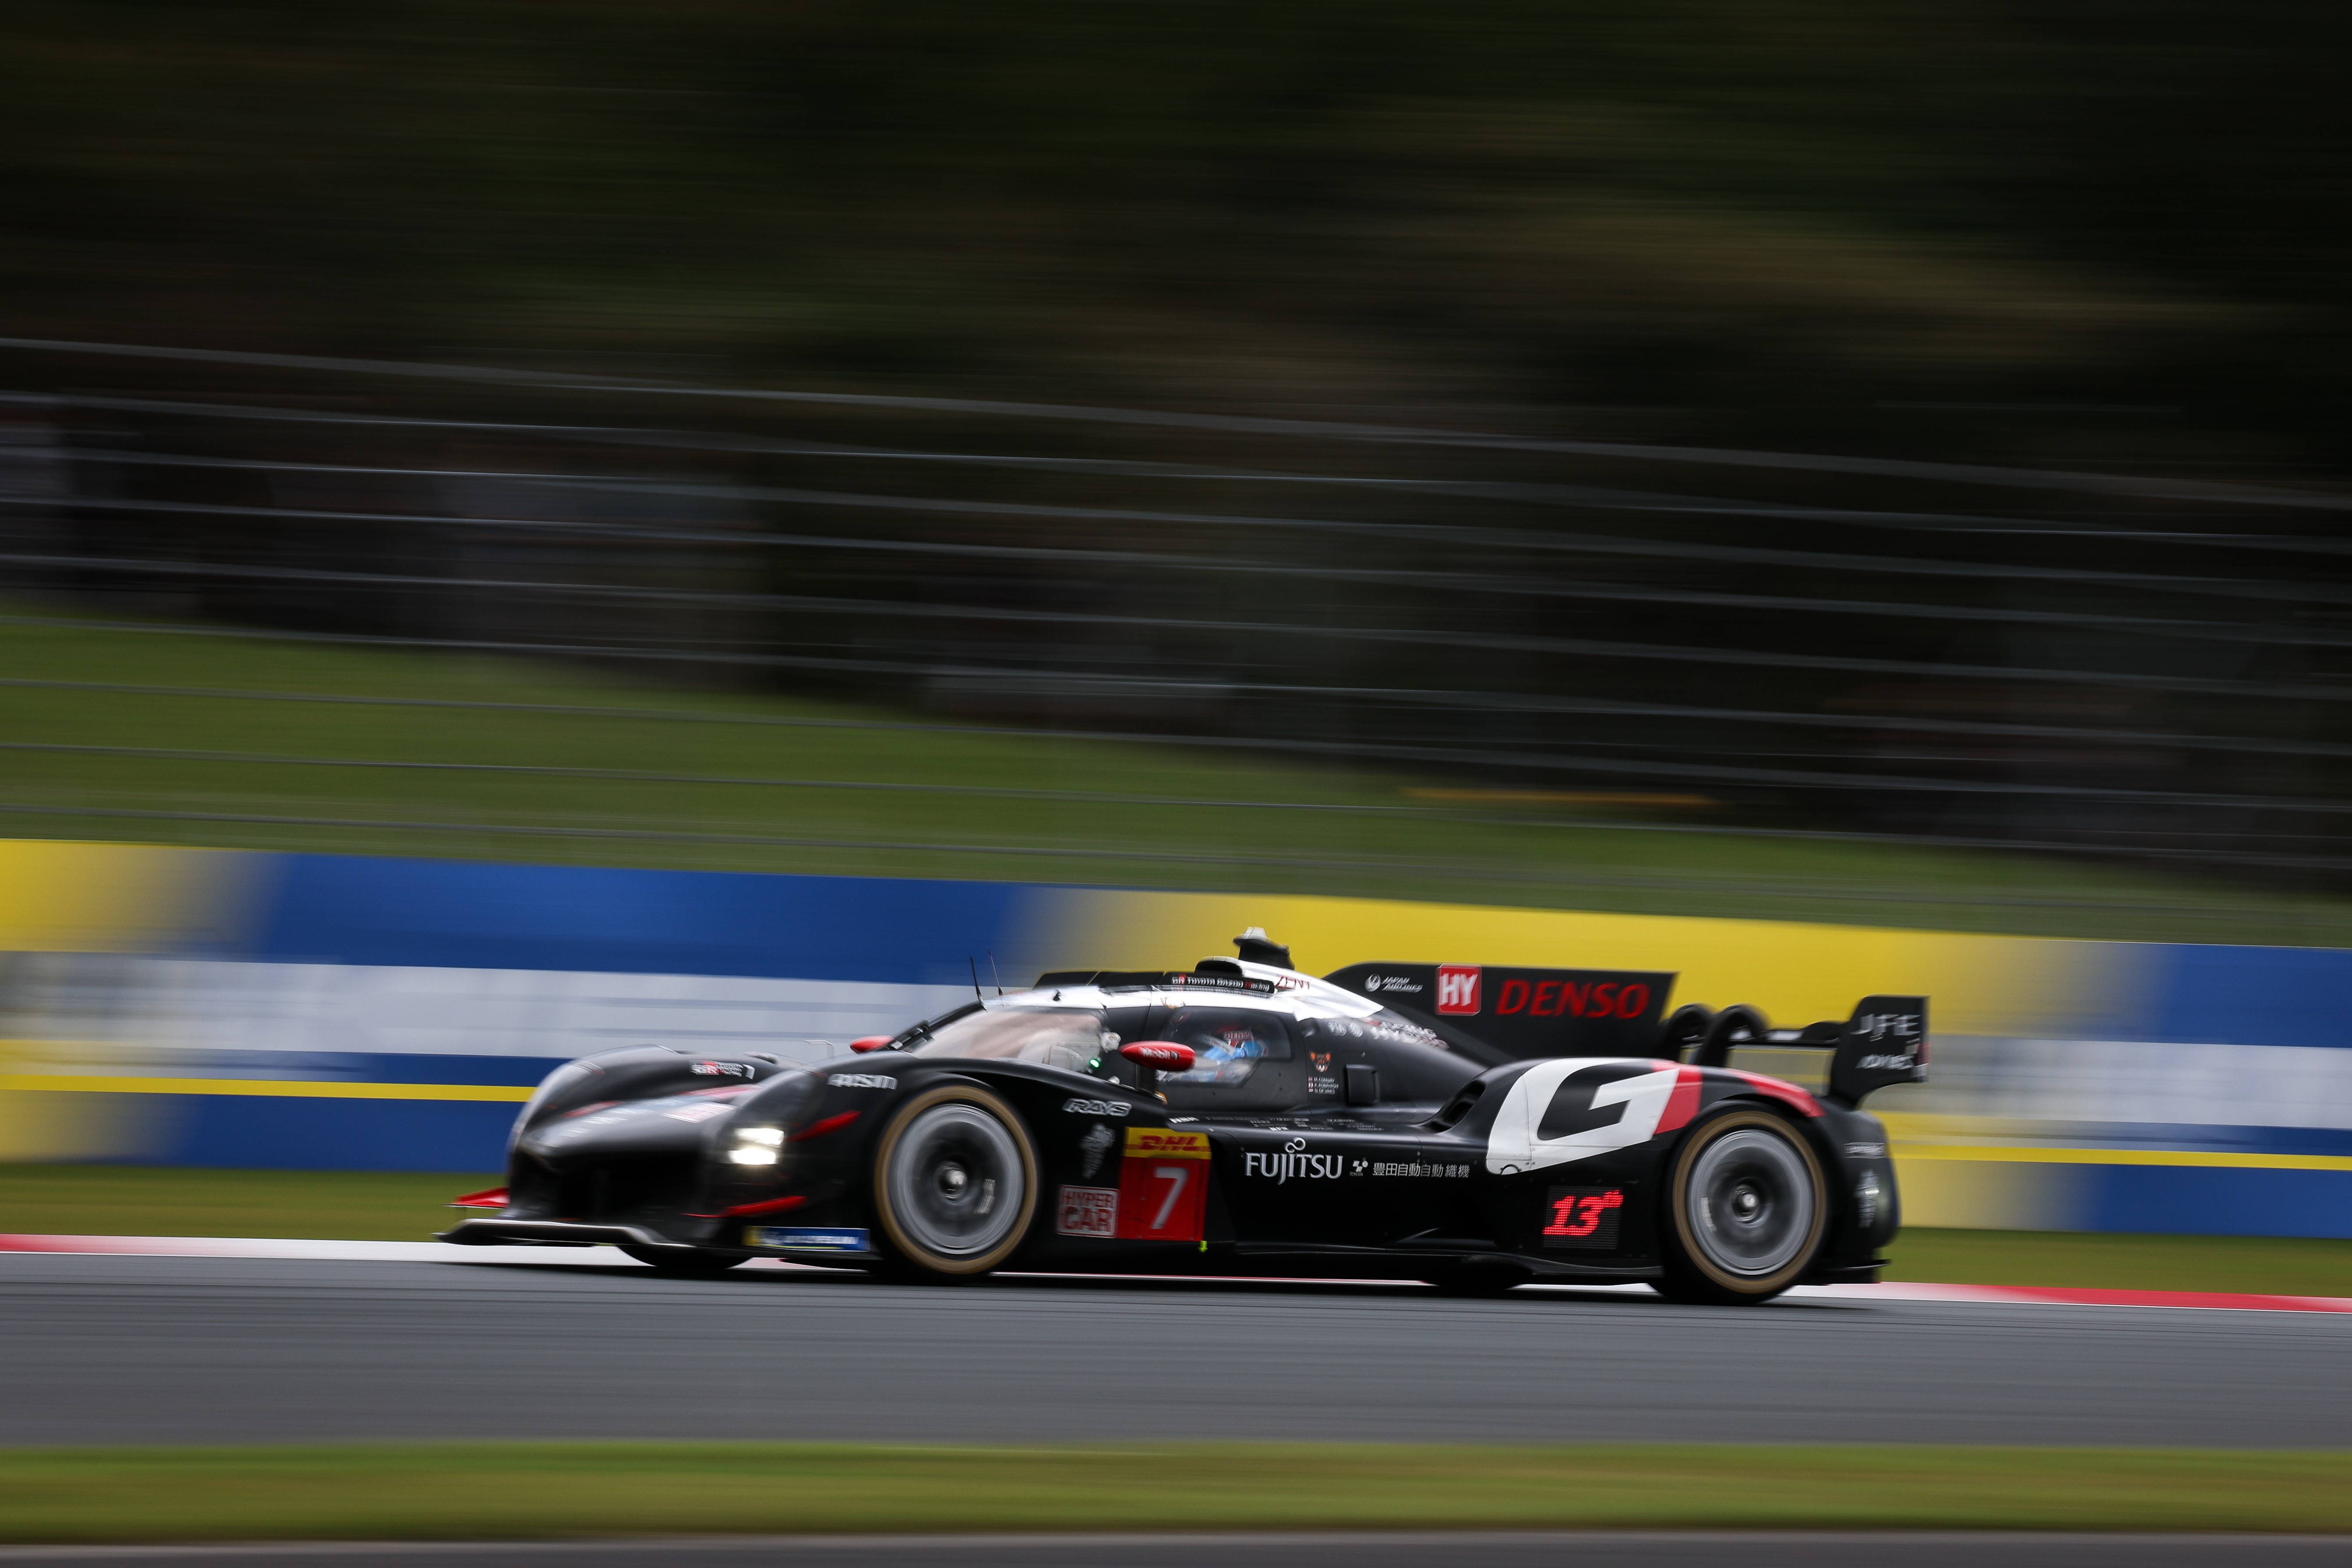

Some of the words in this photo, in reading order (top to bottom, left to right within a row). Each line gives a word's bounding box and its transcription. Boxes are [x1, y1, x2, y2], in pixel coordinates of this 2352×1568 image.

[1382, 983, 1423, 992] AIRLINES
[1439, 973, 1479, 1006] HY
[1494, 978, 1650, 1019] DENSO
[1850, 1014, 1921, 1035] JFE
[1062, 1098, 1132, 1117] RAYS
[1139, 1135, 1201, 1152] DHL
[1244, 1152, 1343, 1185] FUJITSU
[1064, 1190, 1113, 1209] HYPER
[1150, 1166, 1190, 1230] 7
[1063, 1205, 1112, 1233] CAR
